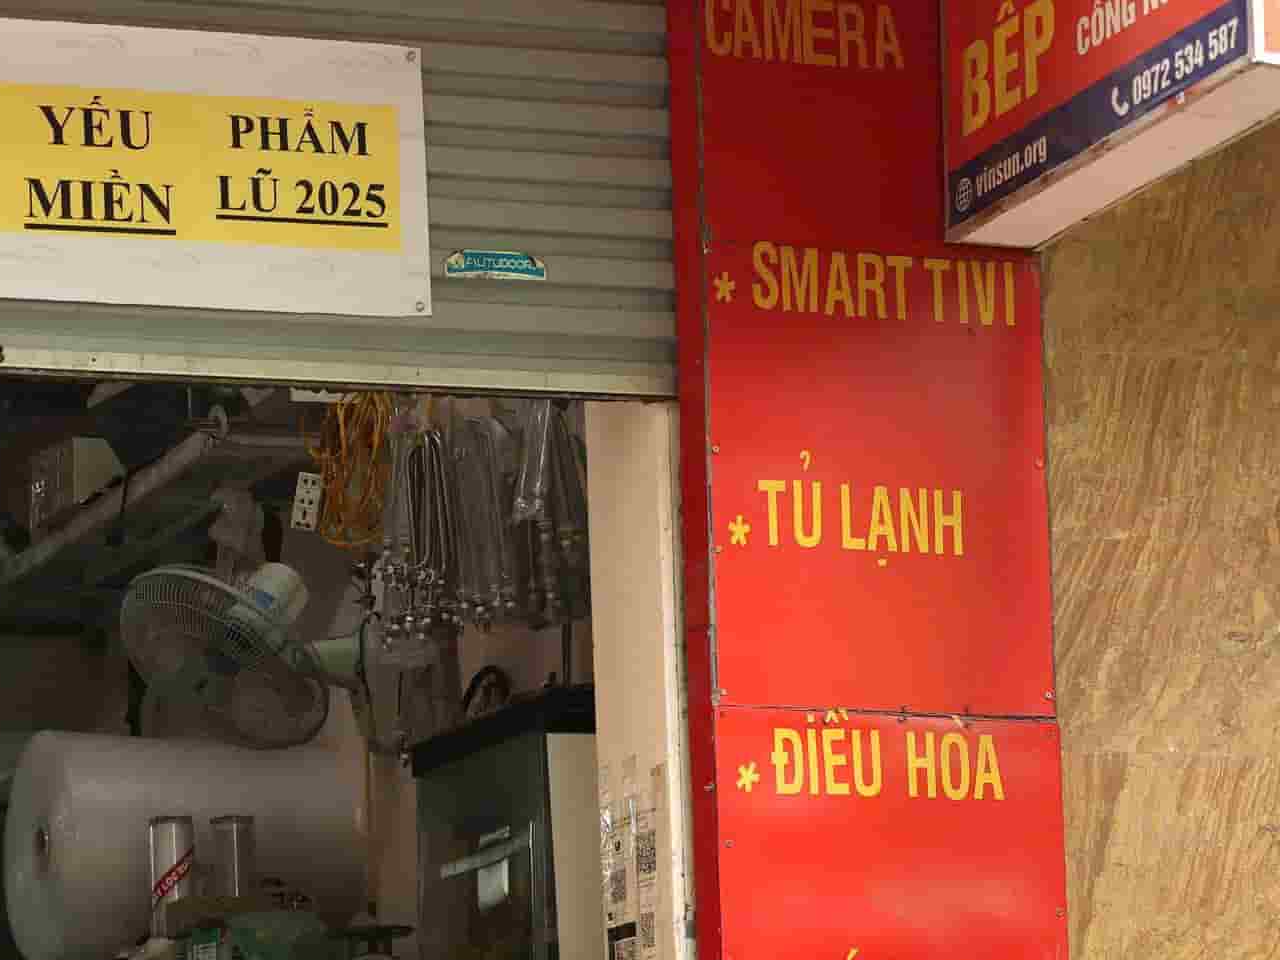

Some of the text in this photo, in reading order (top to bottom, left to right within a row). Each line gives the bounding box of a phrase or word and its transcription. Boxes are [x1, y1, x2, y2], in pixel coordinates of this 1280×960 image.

[704, 0, 904, 70] CAMERA
[962, 0, 1055, 137] BẾP
[1131, 16, 1240, 106] 0972 534 587
[38, 96, 153, 151] YẾU
[974, 135, 1048, 197] vinsun.org
[25, 169, 175, 225] MIỀN
[217, 167, 281, 214] LŨ
[294, 179, 387, 218] 2025
[752, 241, 1017, 326] SMART TIVI
[758, 449, 964, 567] TỦ LẠNH
[770, 707, 1005, 801] ĐIỀU HÒA
